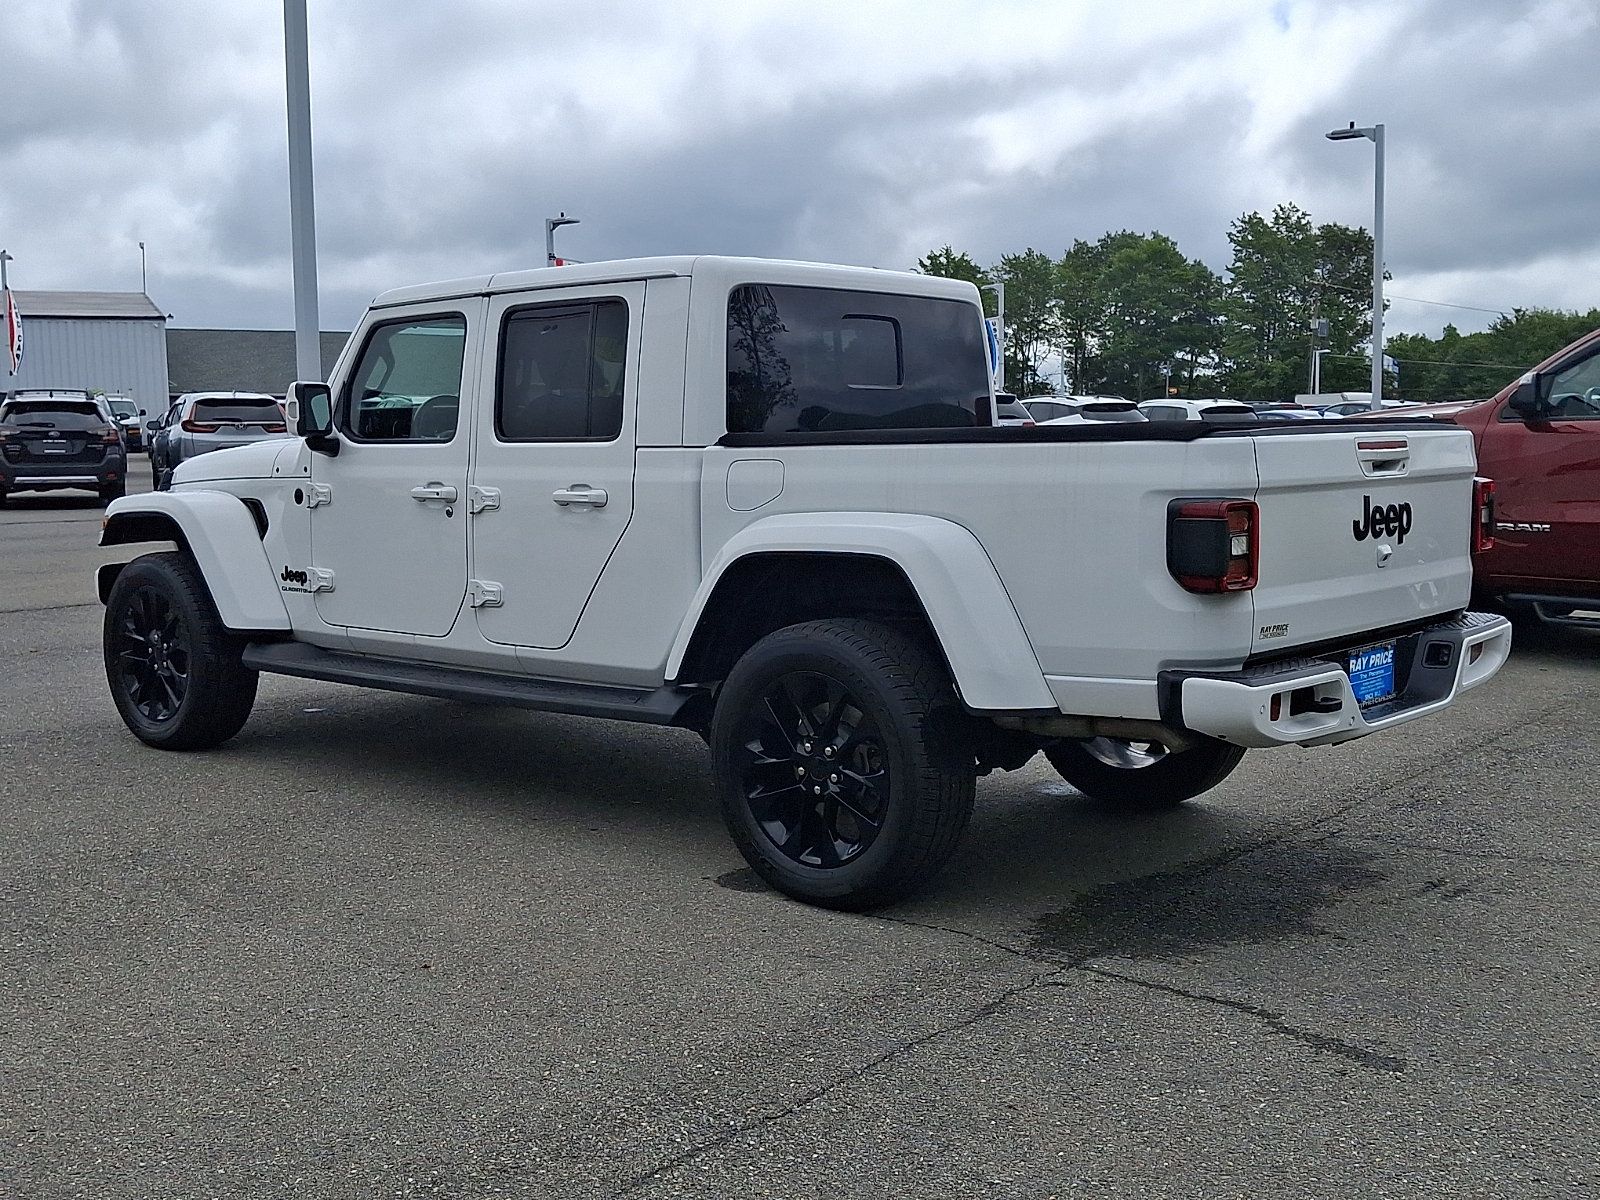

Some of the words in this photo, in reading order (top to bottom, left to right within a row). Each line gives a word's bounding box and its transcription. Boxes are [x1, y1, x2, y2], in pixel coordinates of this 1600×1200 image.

[1352, 495, 1413, 544] Jeep
[281, 565, 308, 587] Jeep
[1260, 625, 1272, 634] RAY
[1272, 623, 1290, 632] PRICE
[1349, 656, 1369, 673] RAY
[1369, 650, 1394, 668] PRICE
